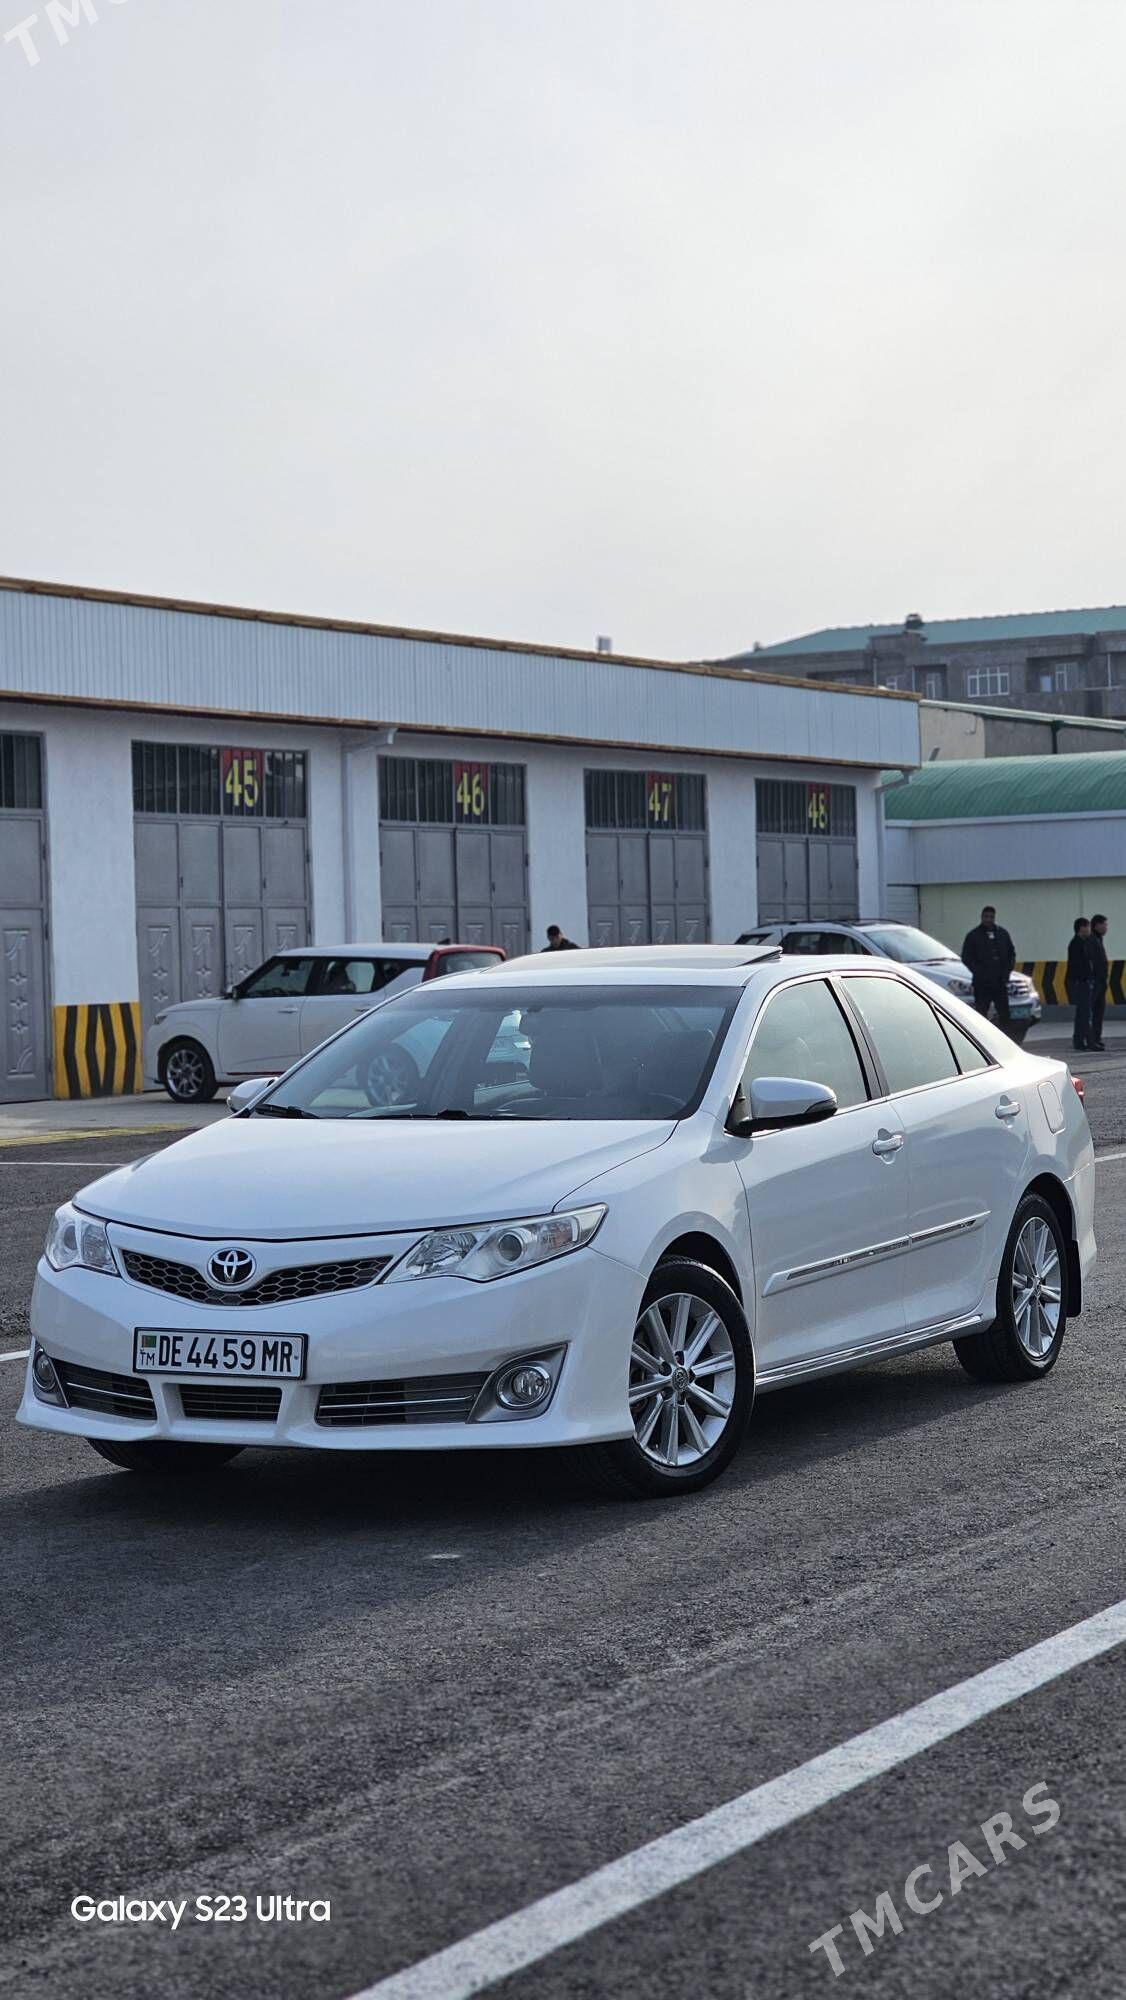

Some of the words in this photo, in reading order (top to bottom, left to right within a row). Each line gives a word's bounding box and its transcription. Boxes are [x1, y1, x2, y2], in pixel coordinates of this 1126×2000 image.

[225, 759, 258, 807] 45
[456, 772, 484, 816] 46
[649, 782, 671, 821] 47
[808, 792, 828, 829] 48
[140, 1351, 155, 1366] TM
